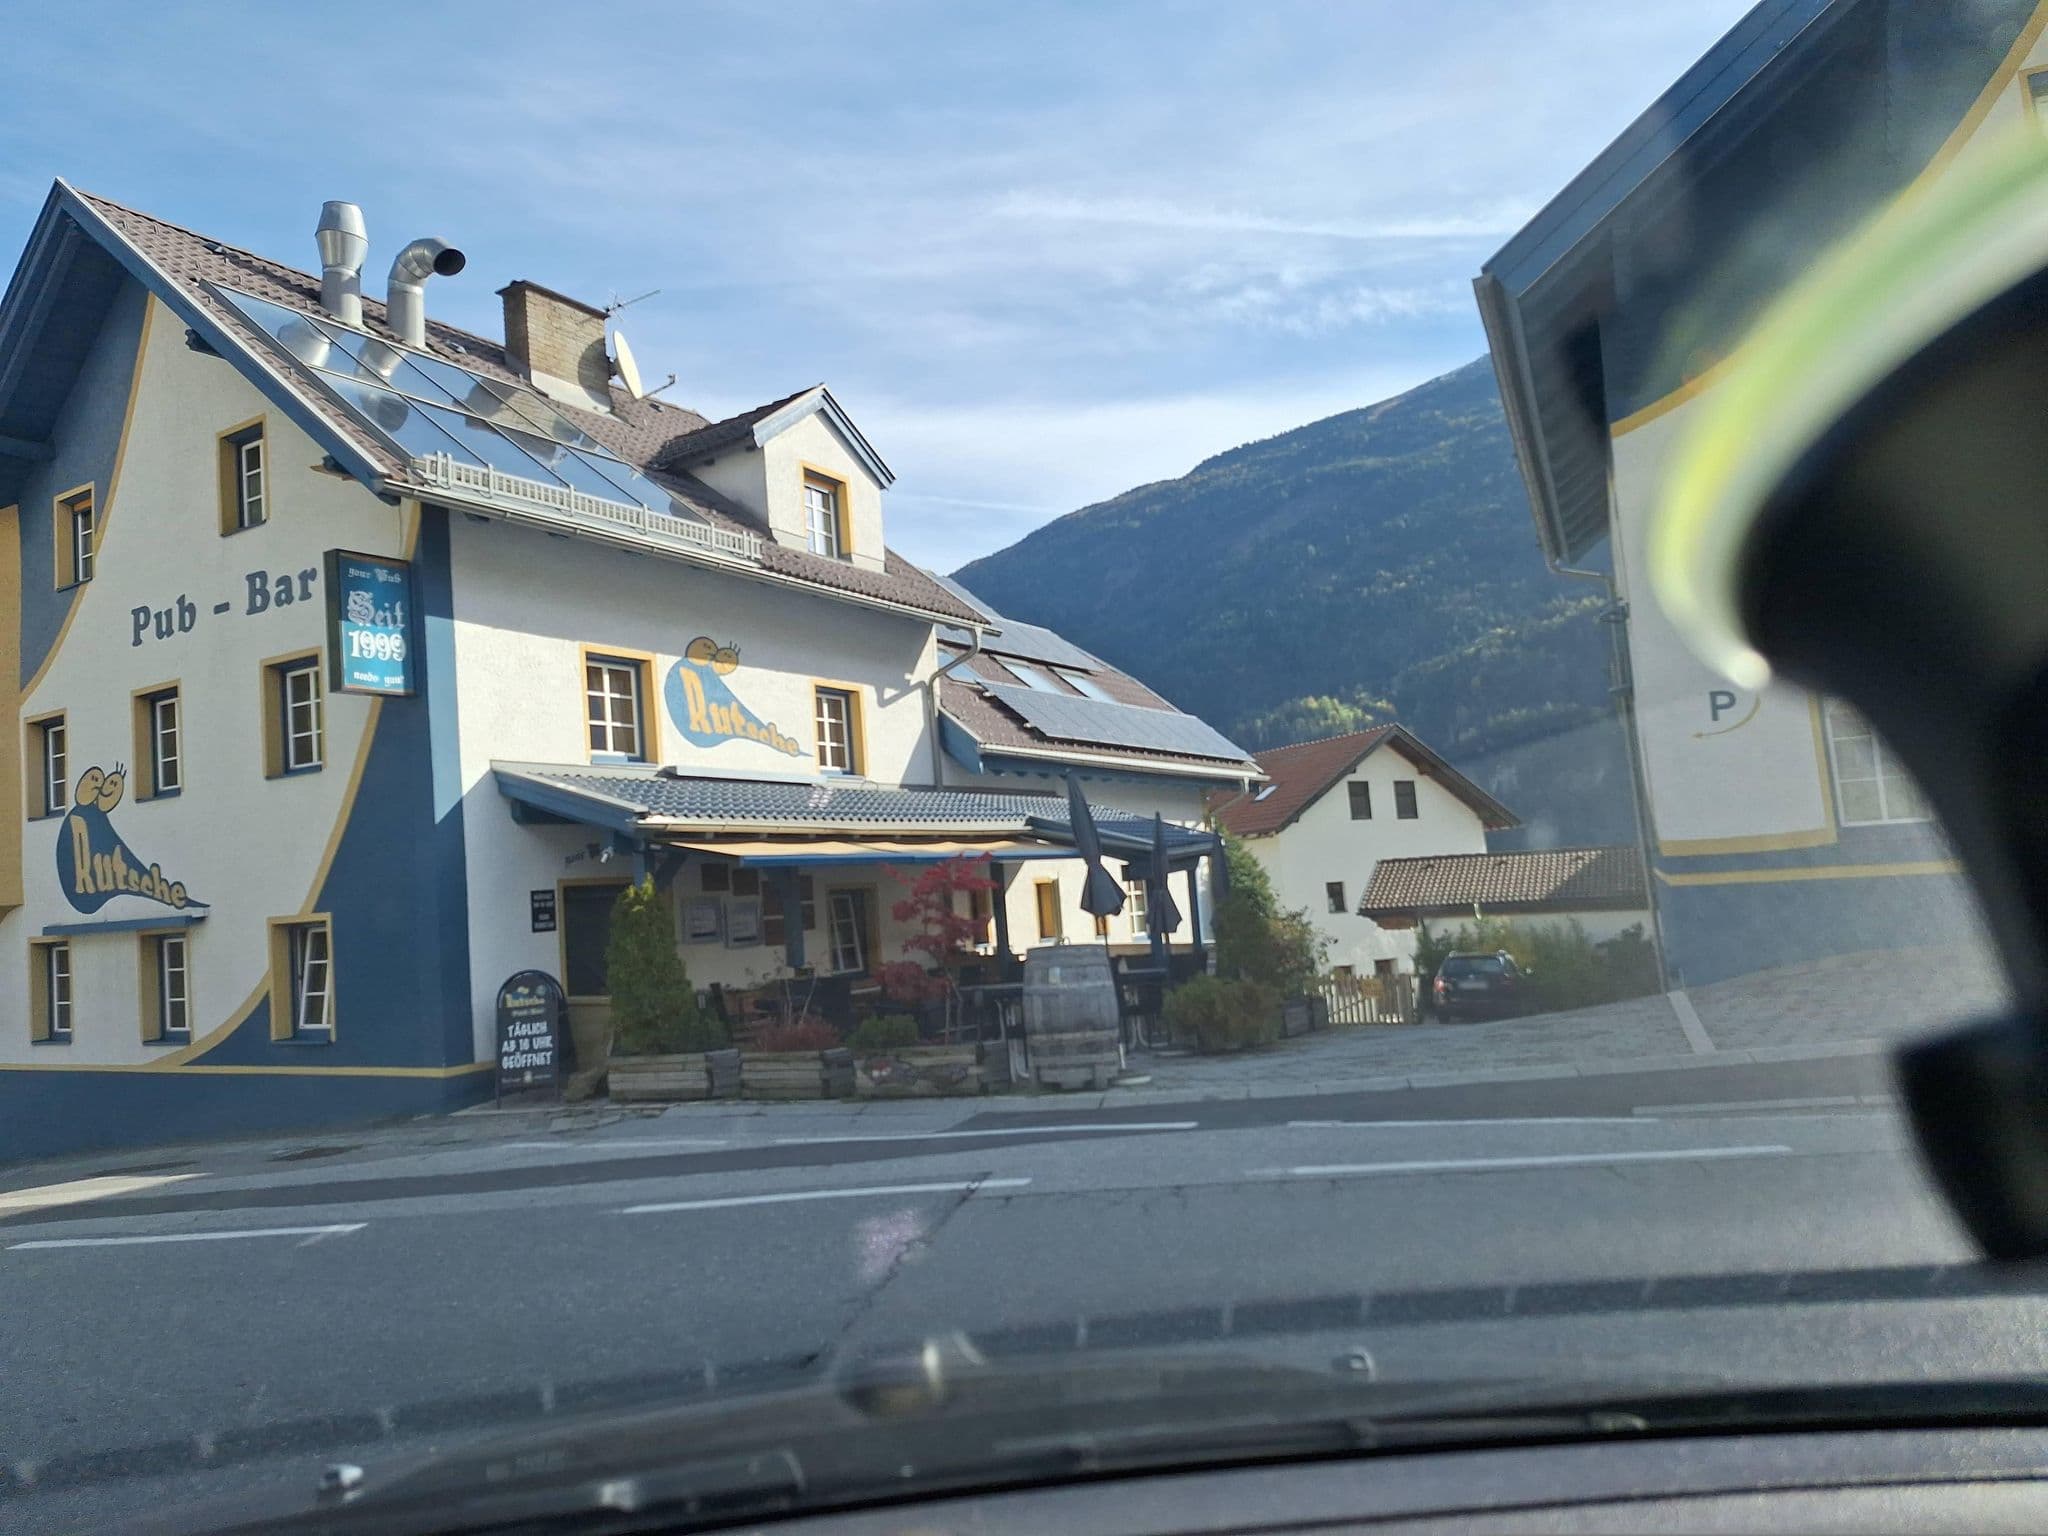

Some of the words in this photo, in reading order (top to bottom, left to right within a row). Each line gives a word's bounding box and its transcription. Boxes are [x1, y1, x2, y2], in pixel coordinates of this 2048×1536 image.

[131, 594, 196, 647] Pub
[245, 567, 318, 616] Bar
[347, 590, 406, 629] Seit
[348, 630, 407, 662] 1999
[679, 666, 800, 757] Rutsche
[1709, 690, 1737, 722] P
[69, 814, 187, 910] Rutsche
[507, 1019, 548, 1038] TÄGLICH
[502, 1039, 516, 1053] AB
[502, 1051, 553, 1070] GEÖFFNET
